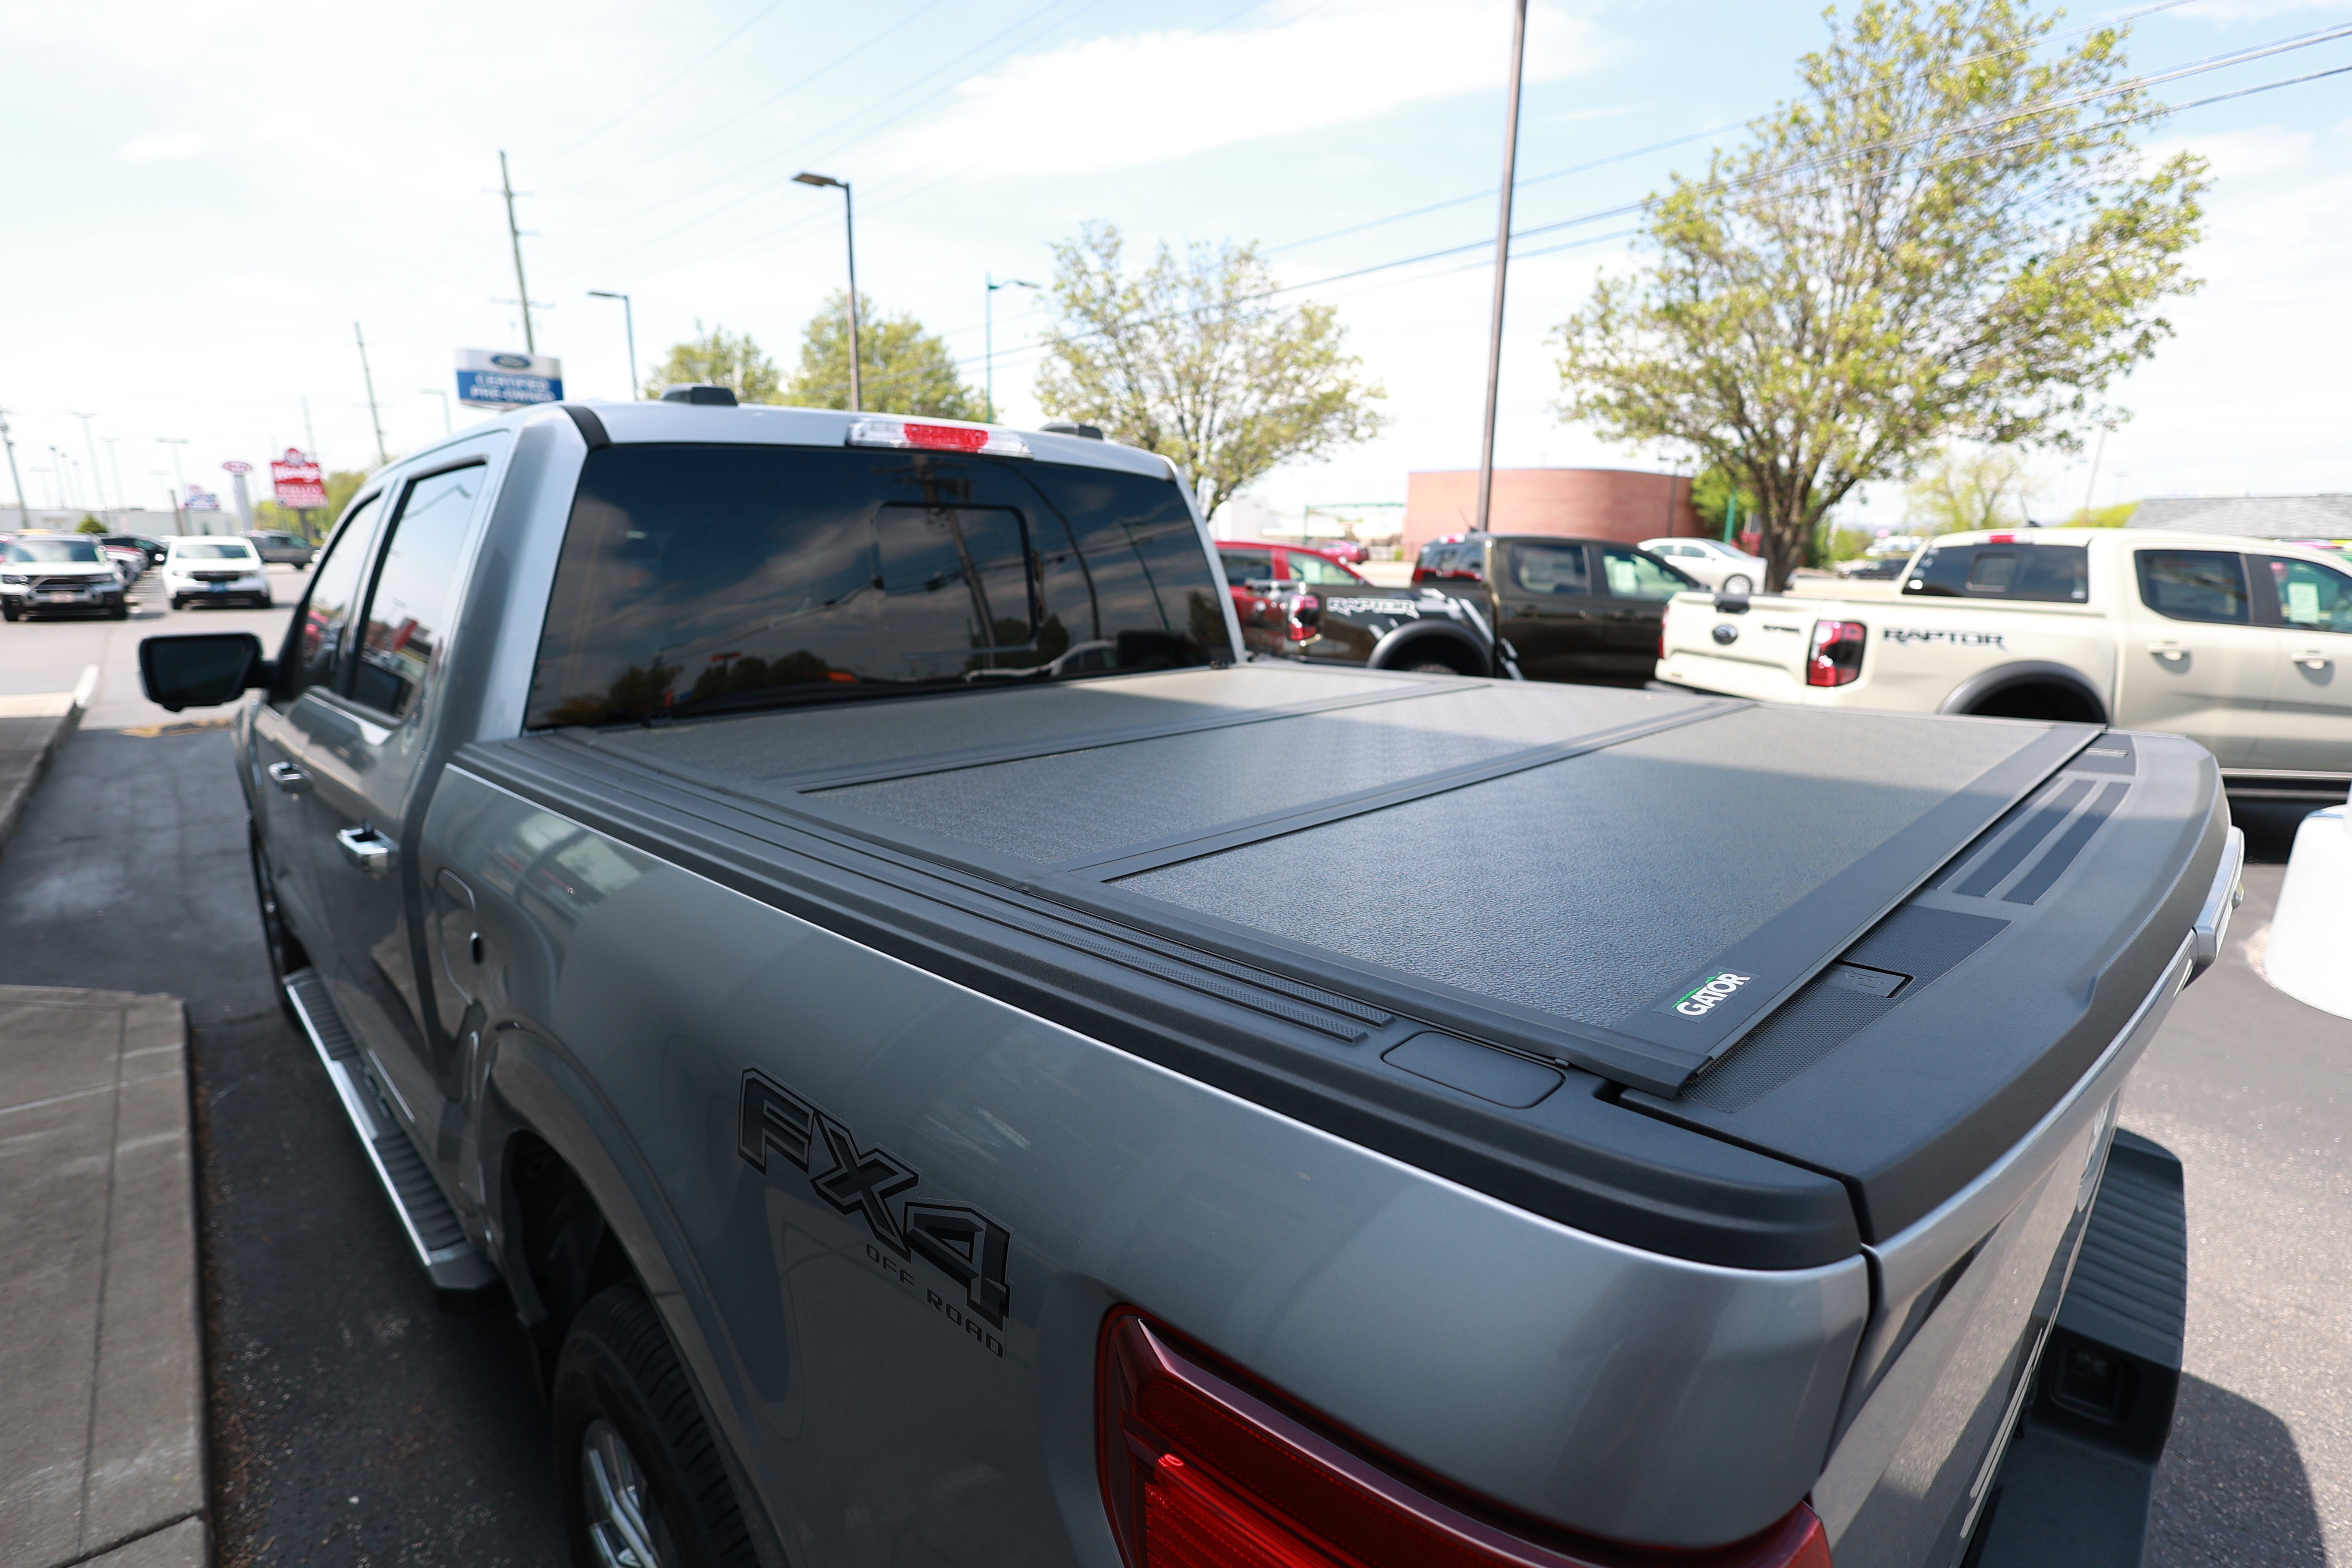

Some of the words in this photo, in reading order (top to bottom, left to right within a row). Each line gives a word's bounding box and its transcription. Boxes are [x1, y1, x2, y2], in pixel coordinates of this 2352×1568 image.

[1884, 630, 2007, 649] RAPTOR
[1676, 973, 1751, 1016] GATOR
[738, 1067, 1011, 1332] FX4
[865, 1243, 915, 1286] OFF
[927, 1288, 1004, 1358] ROAD
